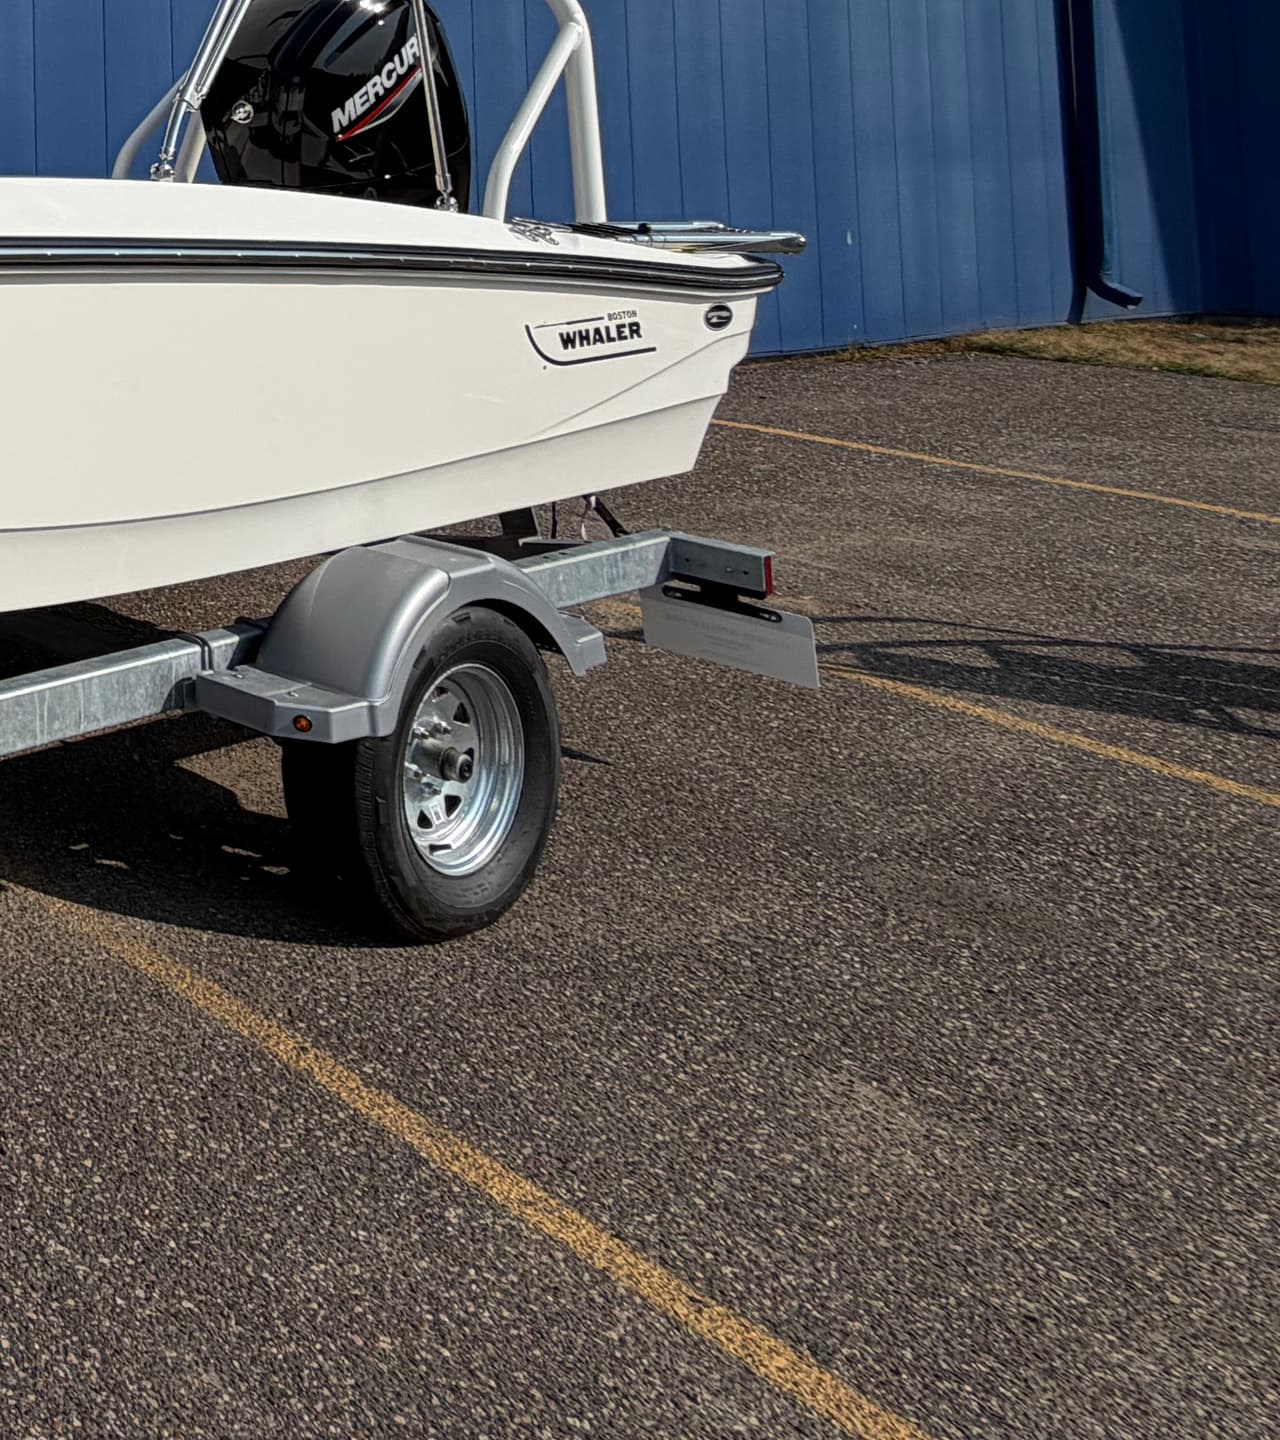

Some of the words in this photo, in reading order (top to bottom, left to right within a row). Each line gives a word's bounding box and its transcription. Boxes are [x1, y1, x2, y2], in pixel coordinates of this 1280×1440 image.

[331, 34, 422, 133] MERCUR
[606, 309, 638, 322] BOSTON
[558, 321, 643, 350] WHALER
